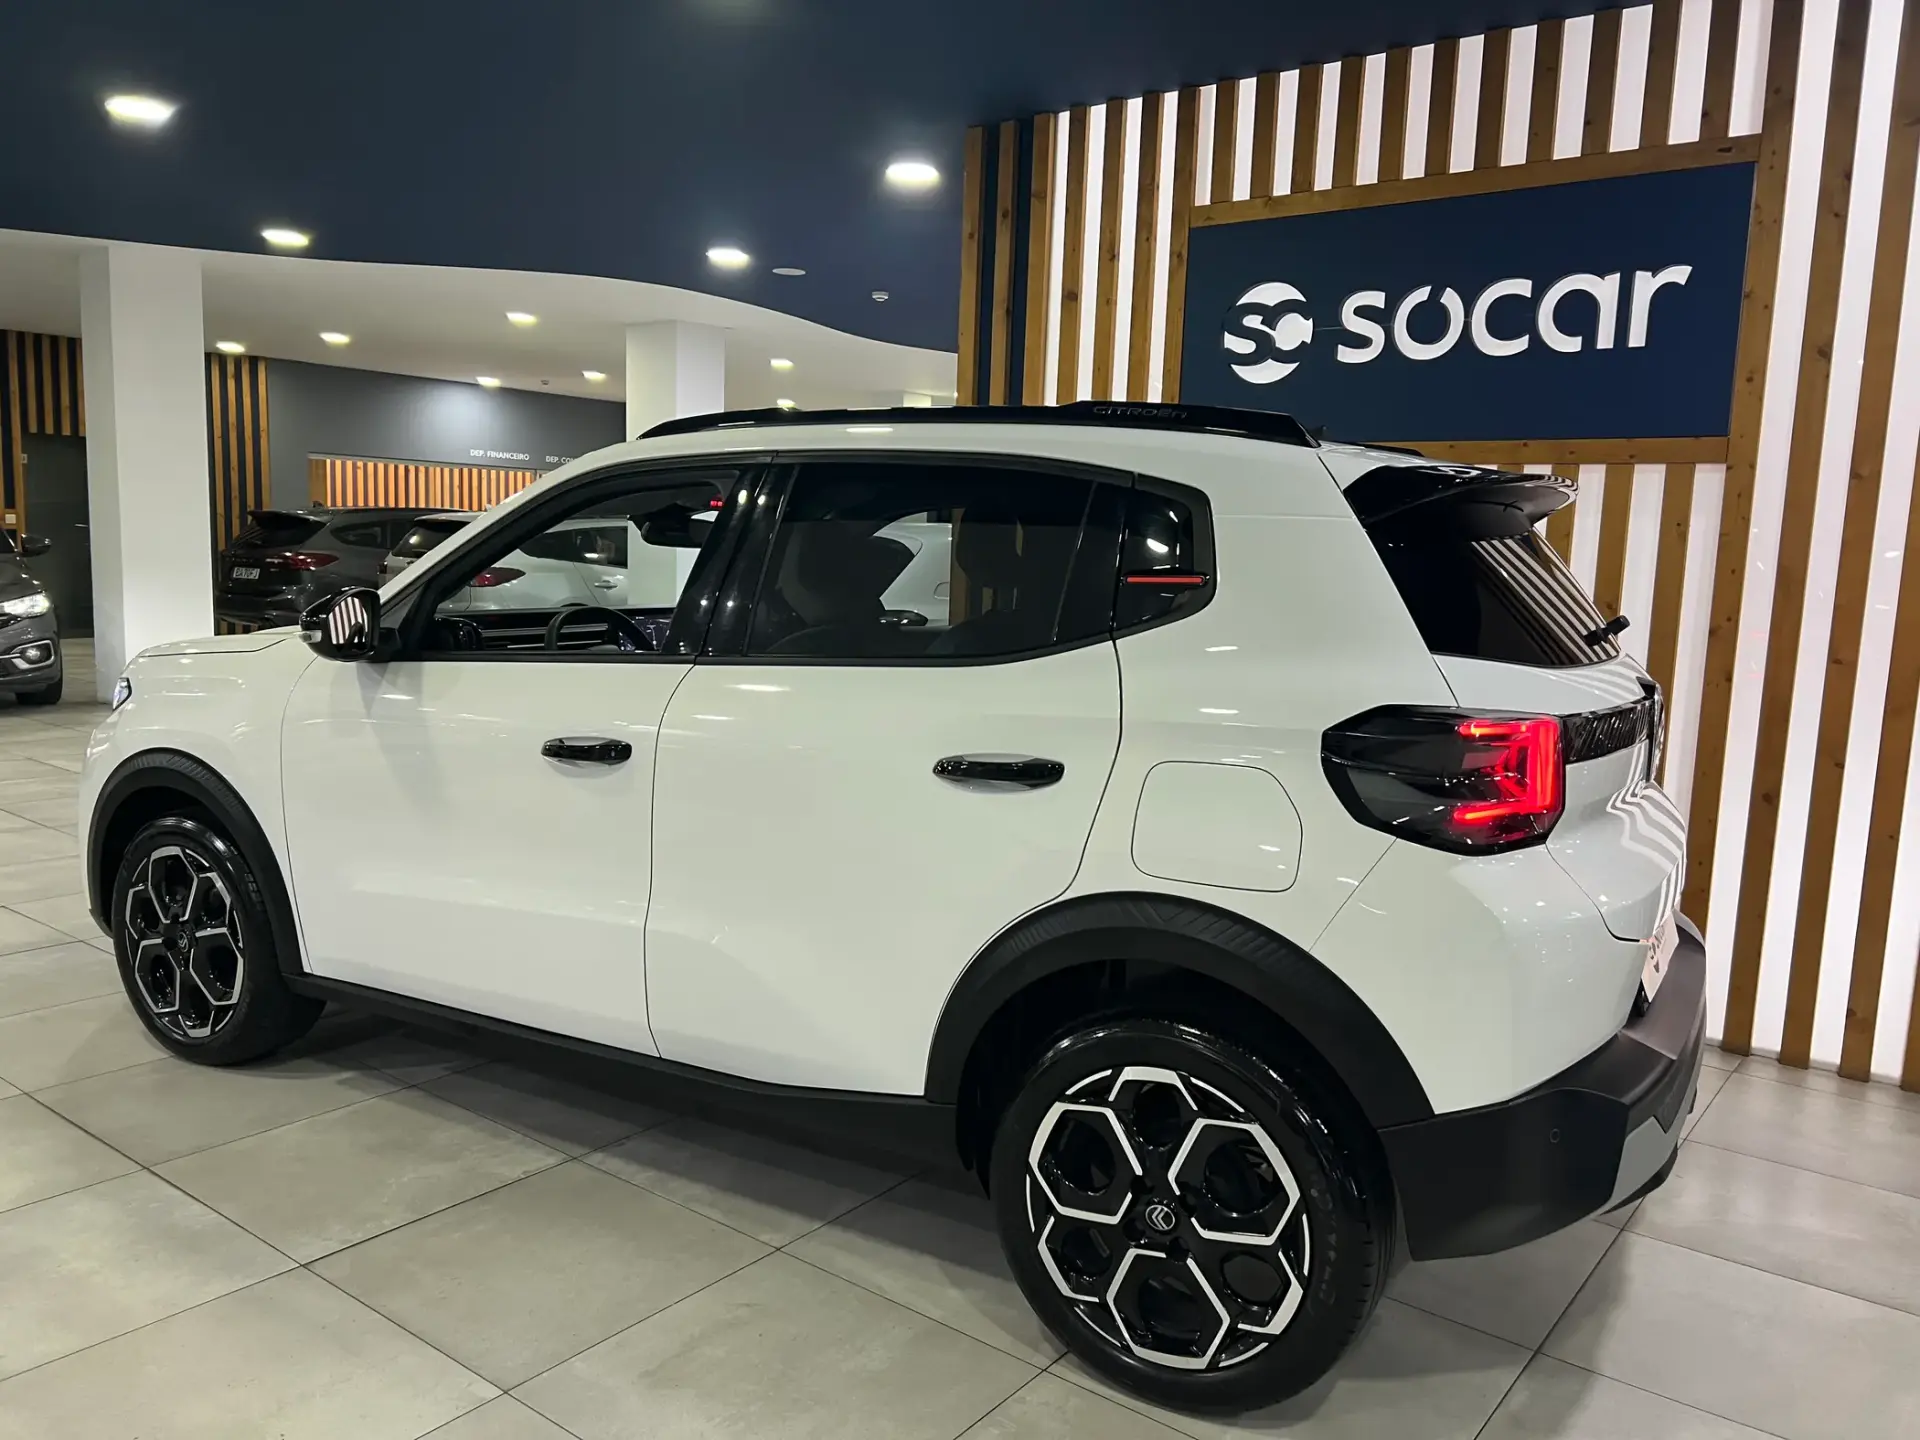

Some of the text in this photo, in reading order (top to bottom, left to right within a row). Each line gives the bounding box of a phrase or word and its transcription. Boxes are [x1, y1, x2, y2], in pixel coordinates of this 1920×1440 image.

[1336, 264, 1693, 364] socar
[470, 449, 530, 461] DEP. FINANCEIRO
[545, 455, 560, 464] DEP.
